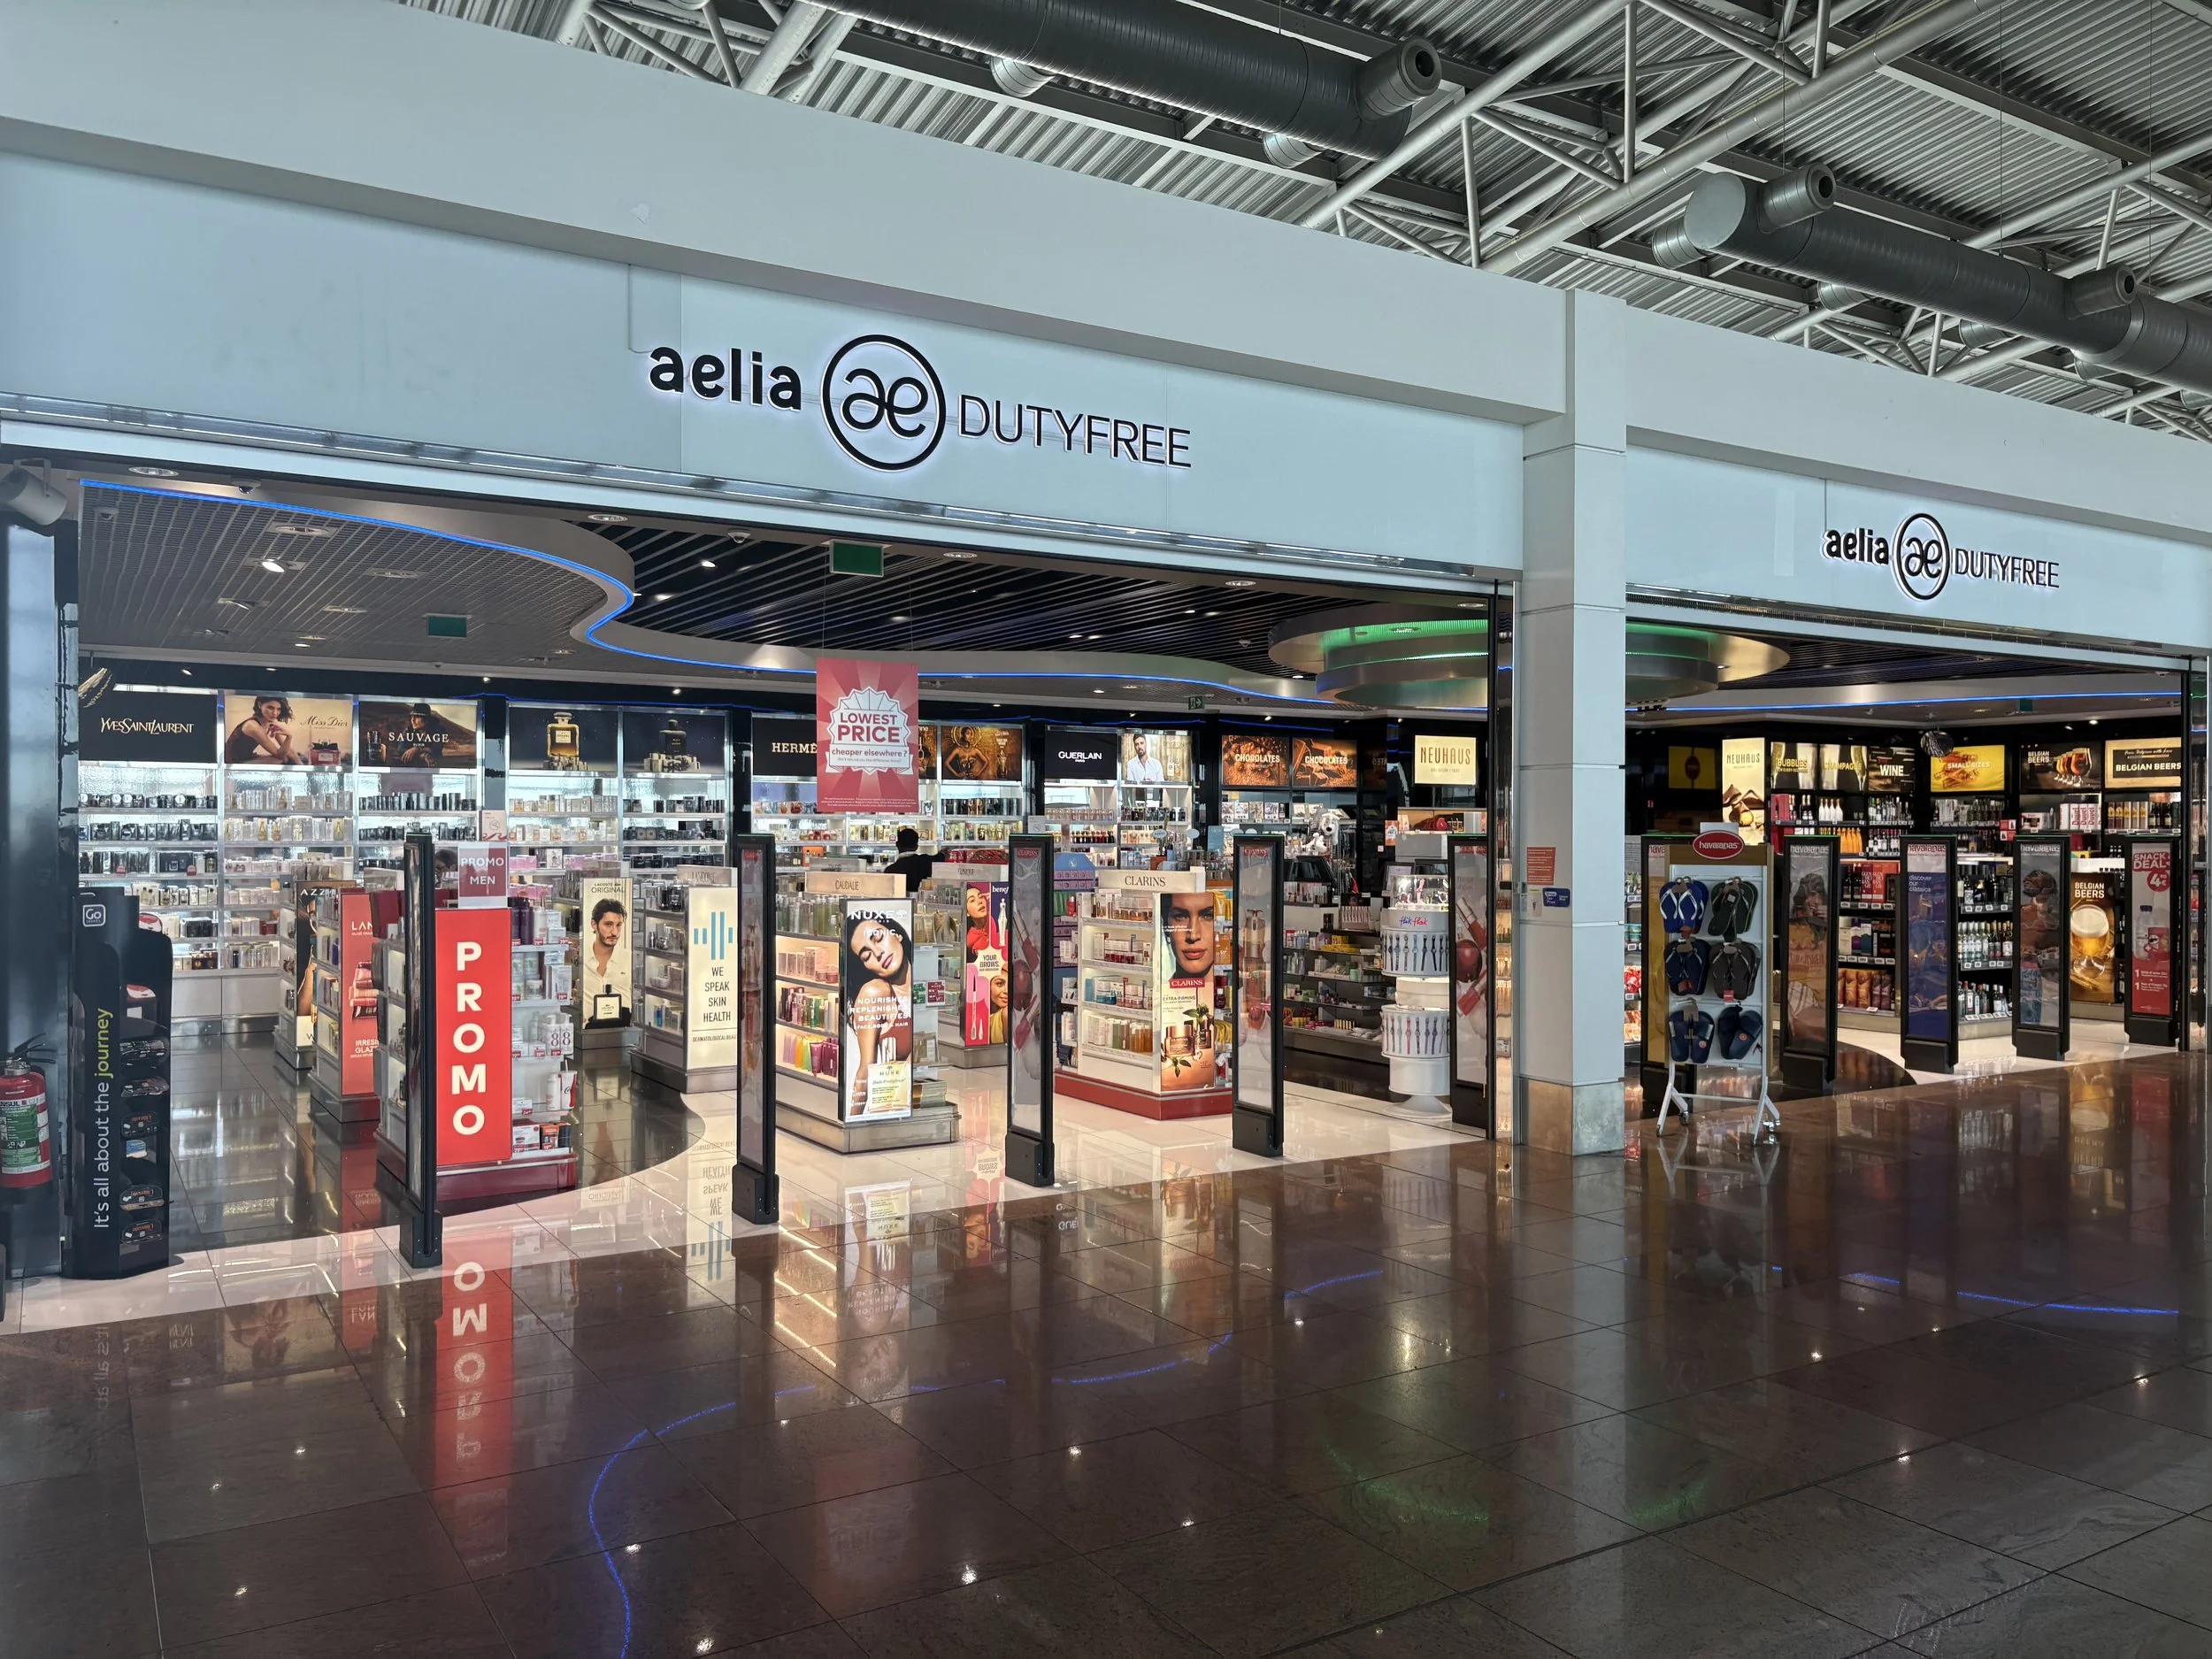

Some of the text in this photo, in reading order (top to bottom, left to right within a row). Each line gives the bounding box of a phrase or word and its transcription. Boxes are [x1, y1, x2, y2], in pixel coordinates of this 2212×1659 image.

[649, 345, 802, 412] aelia
[958, 394, 1192, 468] DUTYFREE
[1825, 528, 1890, 565] aelia
[1955, 547, 2060, 588] DUTYFREE
[300, 716, 348, 726] Miss Dior
[840, 712, 897, 726] LOWEST
[388, 732, 449, 743] SAUVAGE
[837, 725, 901, 743] PRICE
[832, 748, 863, 757] cheaper
[864, 749, 902, 757] elsewhere
[1058, 750, 1102, 760] GUERLAIN
[1420, 747, 1471, 765] NEUHAUS
[1235, 753, 1280, 764] CHOCOLATES
[1304, 756, 1348, 764] CHOCOLATES
[1726, 753, 1761, 764] NEUHAUS
[1777, 758, 1809, 768] BUBBLES
[1879, 764, 1904, 777] WINE
[2116, 762, 2181, 772] BELGIAN BEERS
[1699, 841, 1739, 850] havaianas
[460, 856, 504, 867] PROMO
[2134, 852, 2166, 861] SNACK
[2133, 859, 2167, 870] DEAL
[470, 875, 495, 885] MEN
[1125, 875, 1166, 887] CLARINS
[2074, 881, 2105, 890] BELGIAN
[2074, 889, 2105, 899] BEERS
[85, 908, 102, 920] Go
[850, 910, 895, 920] NUXE
[1398, 916, 1413, 927] flik
[979, 960, 1000, 969] BROWS.
[711, 966, 725, 977] WE
[704, 980, 730, 992] SPEAK
[708, 996, 726, 1007] SKIN
[857, 996, 909, 1005] NOURISHES
[849, 1005, 909, 1014] REPLENISHES
[703, 1011, 731, 1023] HEALTH
[857, 1013, 909, 1022] BEAUTIFIES
[451, 941, 487, 1135] PROMO
[550, 1033, 559, 1047] 8
[562, 1031, 571, 1046] 8
[93, 1007, 114, 1229] It's all about the journey
